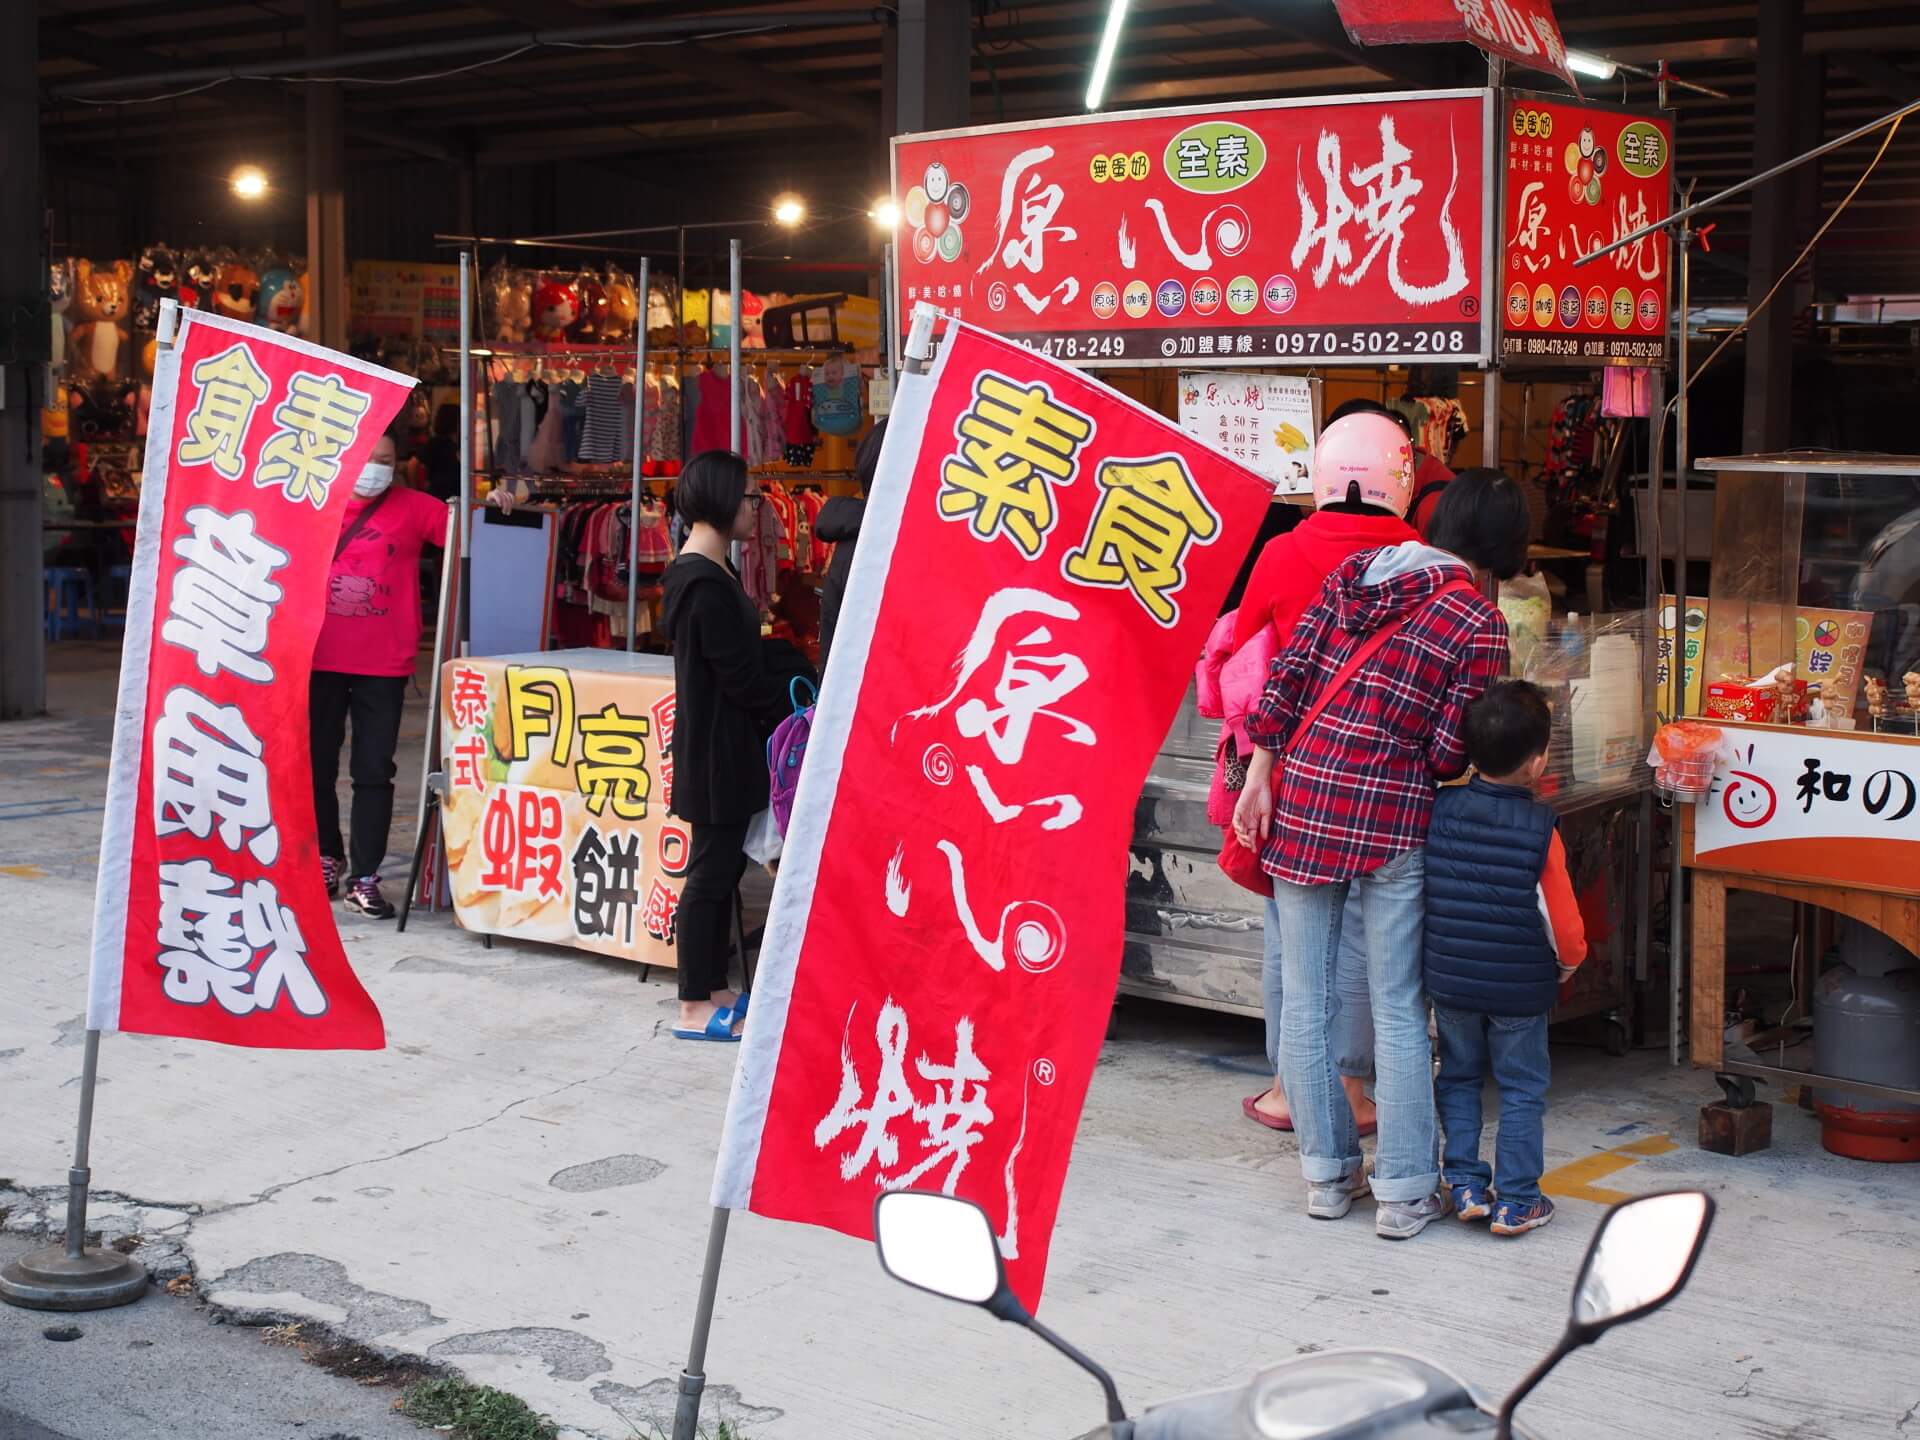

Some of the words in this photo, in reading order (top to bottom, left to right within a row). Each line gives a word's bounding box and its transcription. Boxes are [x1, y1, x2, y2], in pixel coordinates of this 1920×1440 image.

[1093, 155, 1148, 178] 無蛋奶
[1176, 135, 1249, 179] 全素
[1625, 132, 1660, 168] 全素
[1094, 294, 1117, 308] 原味
[1127, 293, 1148, 307] 咖哩
[1160, 292, 1184, 306] 海苔
[1194, 289, 1218, 304] 辣味
[1230, 289, 1255, 303] 芥末
[1267, 287, 1295, 301] 梅子
[1510, 296, 1529, 312] 原味
[1536, 300, 1553, 314] 咖哩
[1613, 302, 1632, 316] 芥末
[1234, 415, 1246, 427] 50
[1250, 417, 1261, 429] 元
[1234, 432, 1246, 445] 60
[1250, 433, 1261, 445] 元
[1234, 448, 1246, 460] 55
[1250, 449, 1261, 461] 元
[937, 369, 1223, 629] 素食
[453, 667, 488, 793] 泰式
[505, 664, 651, 821] 月亮
[1796, 758, 1917, 821] 和の
[480, 787, 641, 946] 蝦餅
